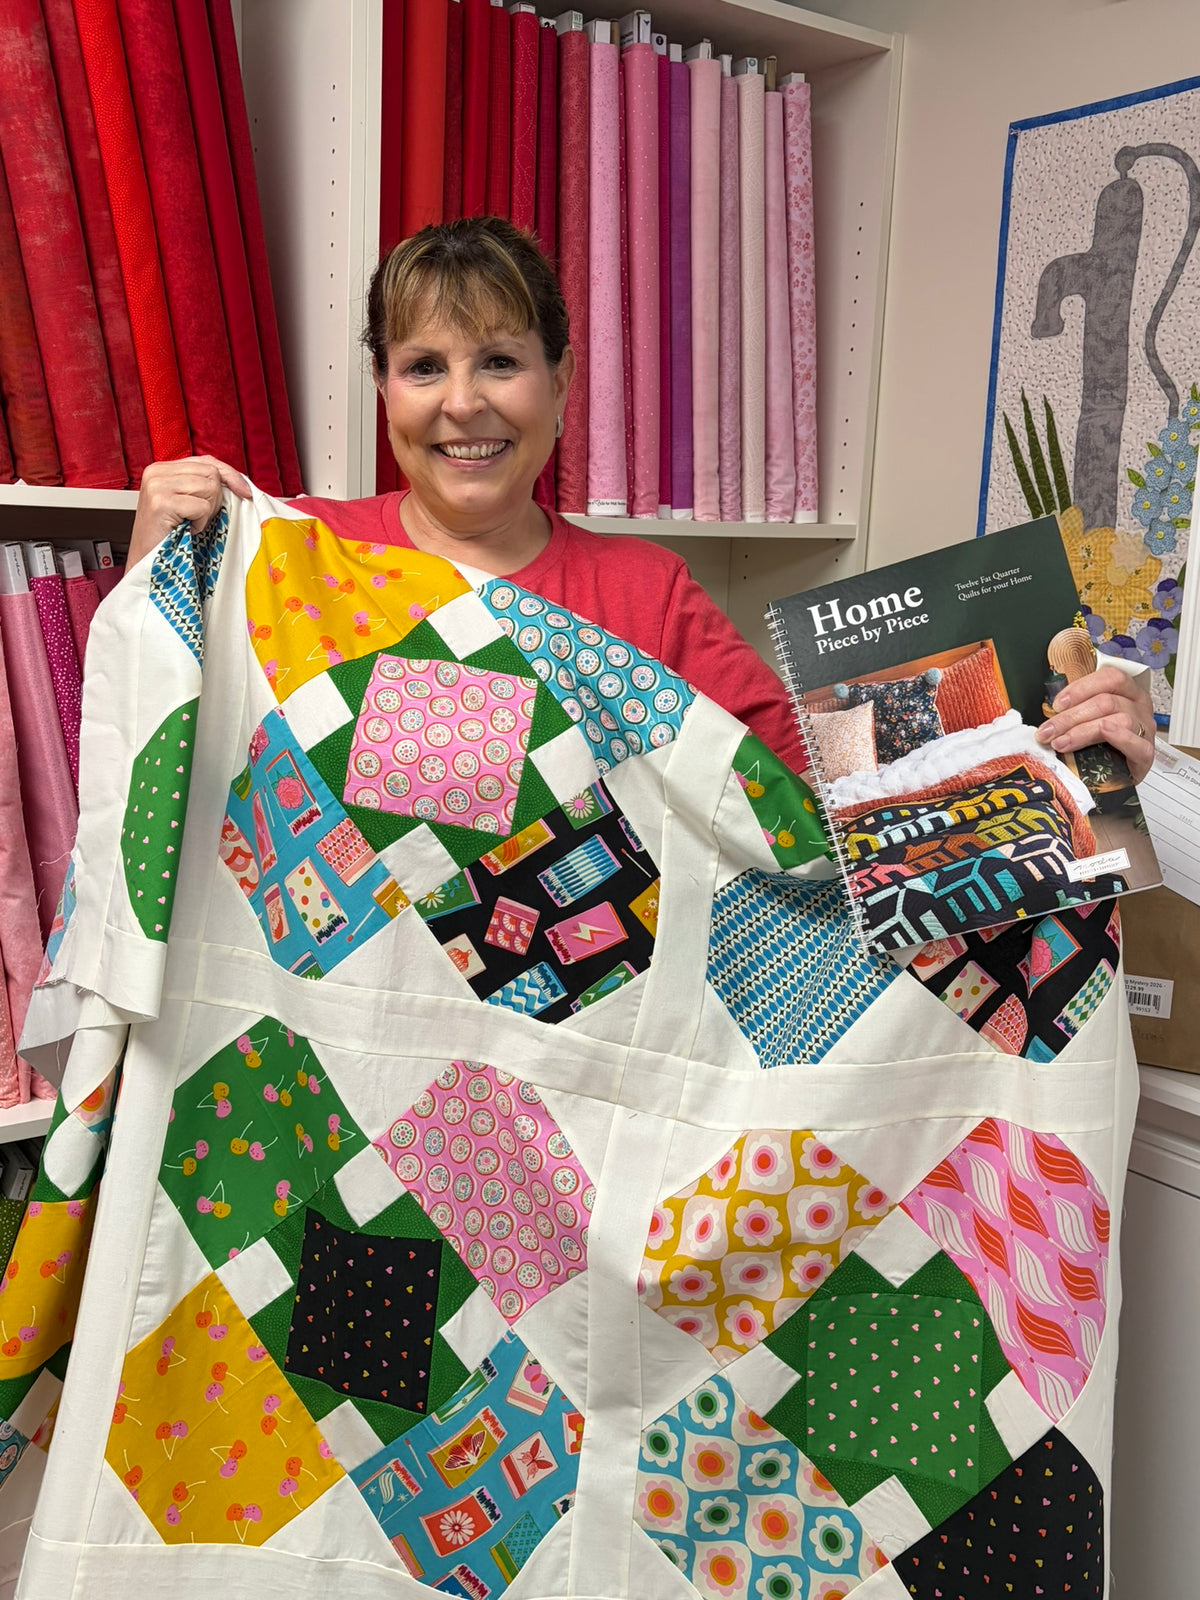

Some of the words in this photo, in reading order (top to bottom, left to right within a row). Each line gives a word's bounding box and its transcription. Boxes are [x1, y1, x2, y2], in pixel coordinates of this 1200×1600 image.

[955, 580, 979, 591] Twelve
[980, 576, 991, 584] Fat
[992, 567, 1020, 580] Quarter
[958, 590, 980, 601] Quilts
[981, 586, 992, 594] for
[993, 581, 1009, 592] your
[1010, 574, 1033, 586] Home
[807, 586, 924, 637] Home
[816, 634, 860, 655] Piece
[860, 626, 882, 643] by
[885, 613, 930, 634] Piece
